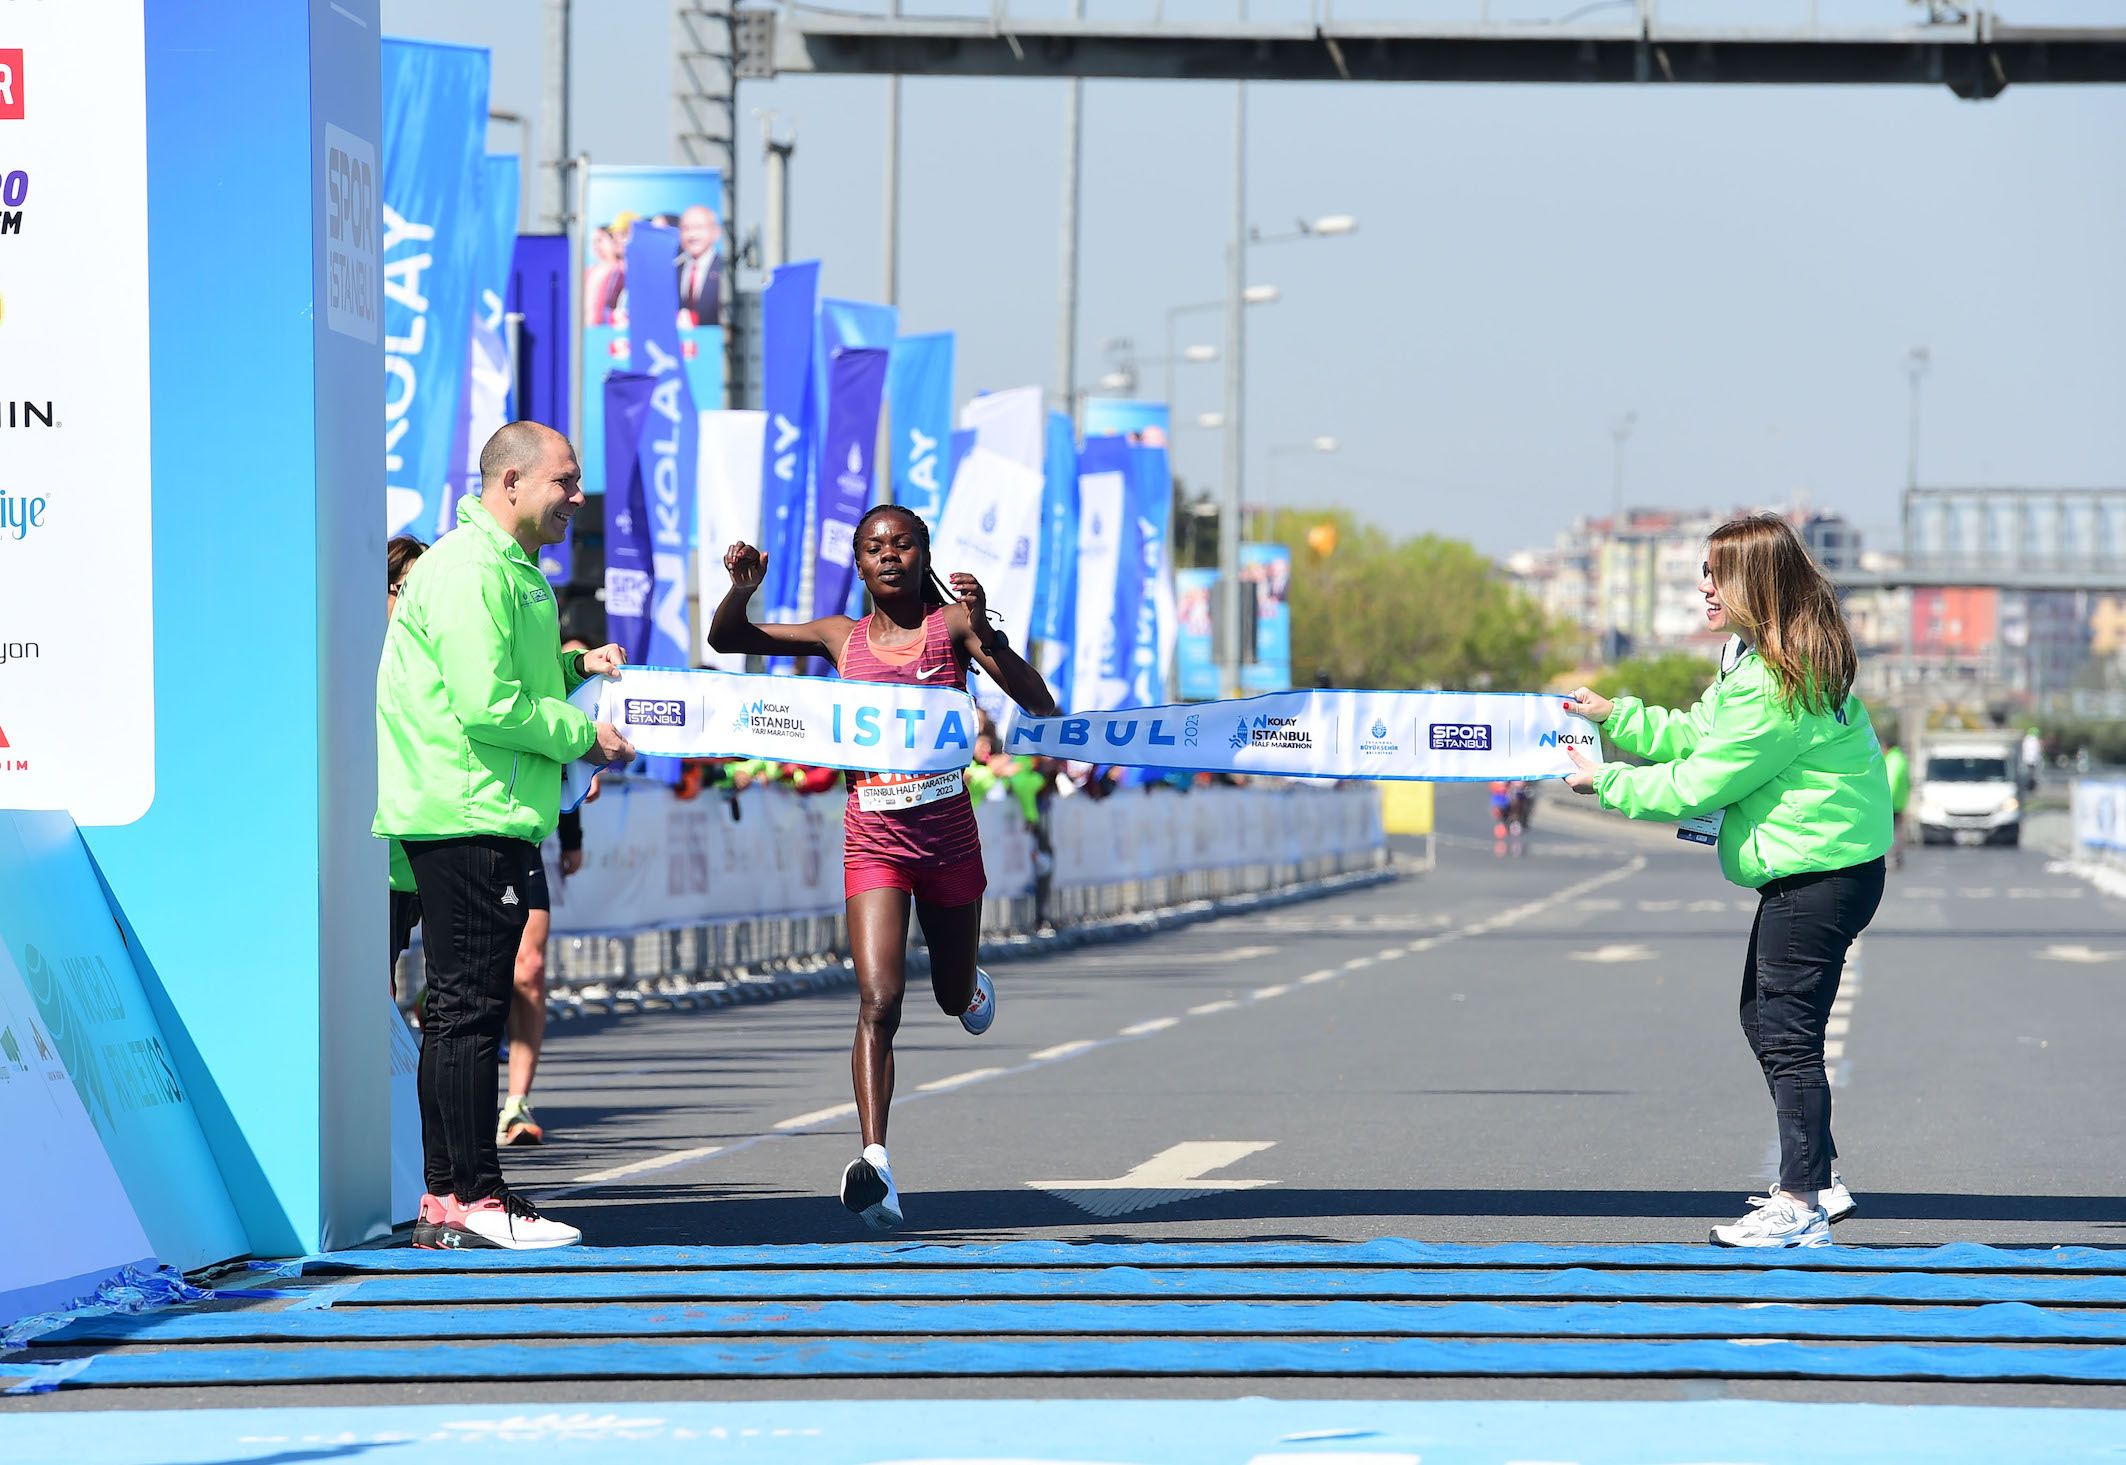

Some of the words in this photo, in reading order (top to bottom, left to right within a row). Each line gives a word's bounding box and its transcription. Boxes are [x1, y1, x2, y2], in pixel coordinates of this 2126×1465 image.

[0, 170, 29, 207] O
[329, 148, 374, 255] SPOR
[0, 211, 22, 235] M
[0, 401, 53, 428] IN
[628, 701, 681, 715] SPOR
[767, 729, 805, 738] MARATONU
[1184, 714, 1200, 747] 2023
[1252, 730, 1312, 742] ISTANBUL
[1432, 726, 1488, 739] SPOR
[0, 761, 28, 771] IM
[864, 788, 896, 797] ISTANBUL
[896, 784, 916, 795] HALF
[917, 772, 960, 790] MARATHON
[936, 785, 954, 797] 2023
